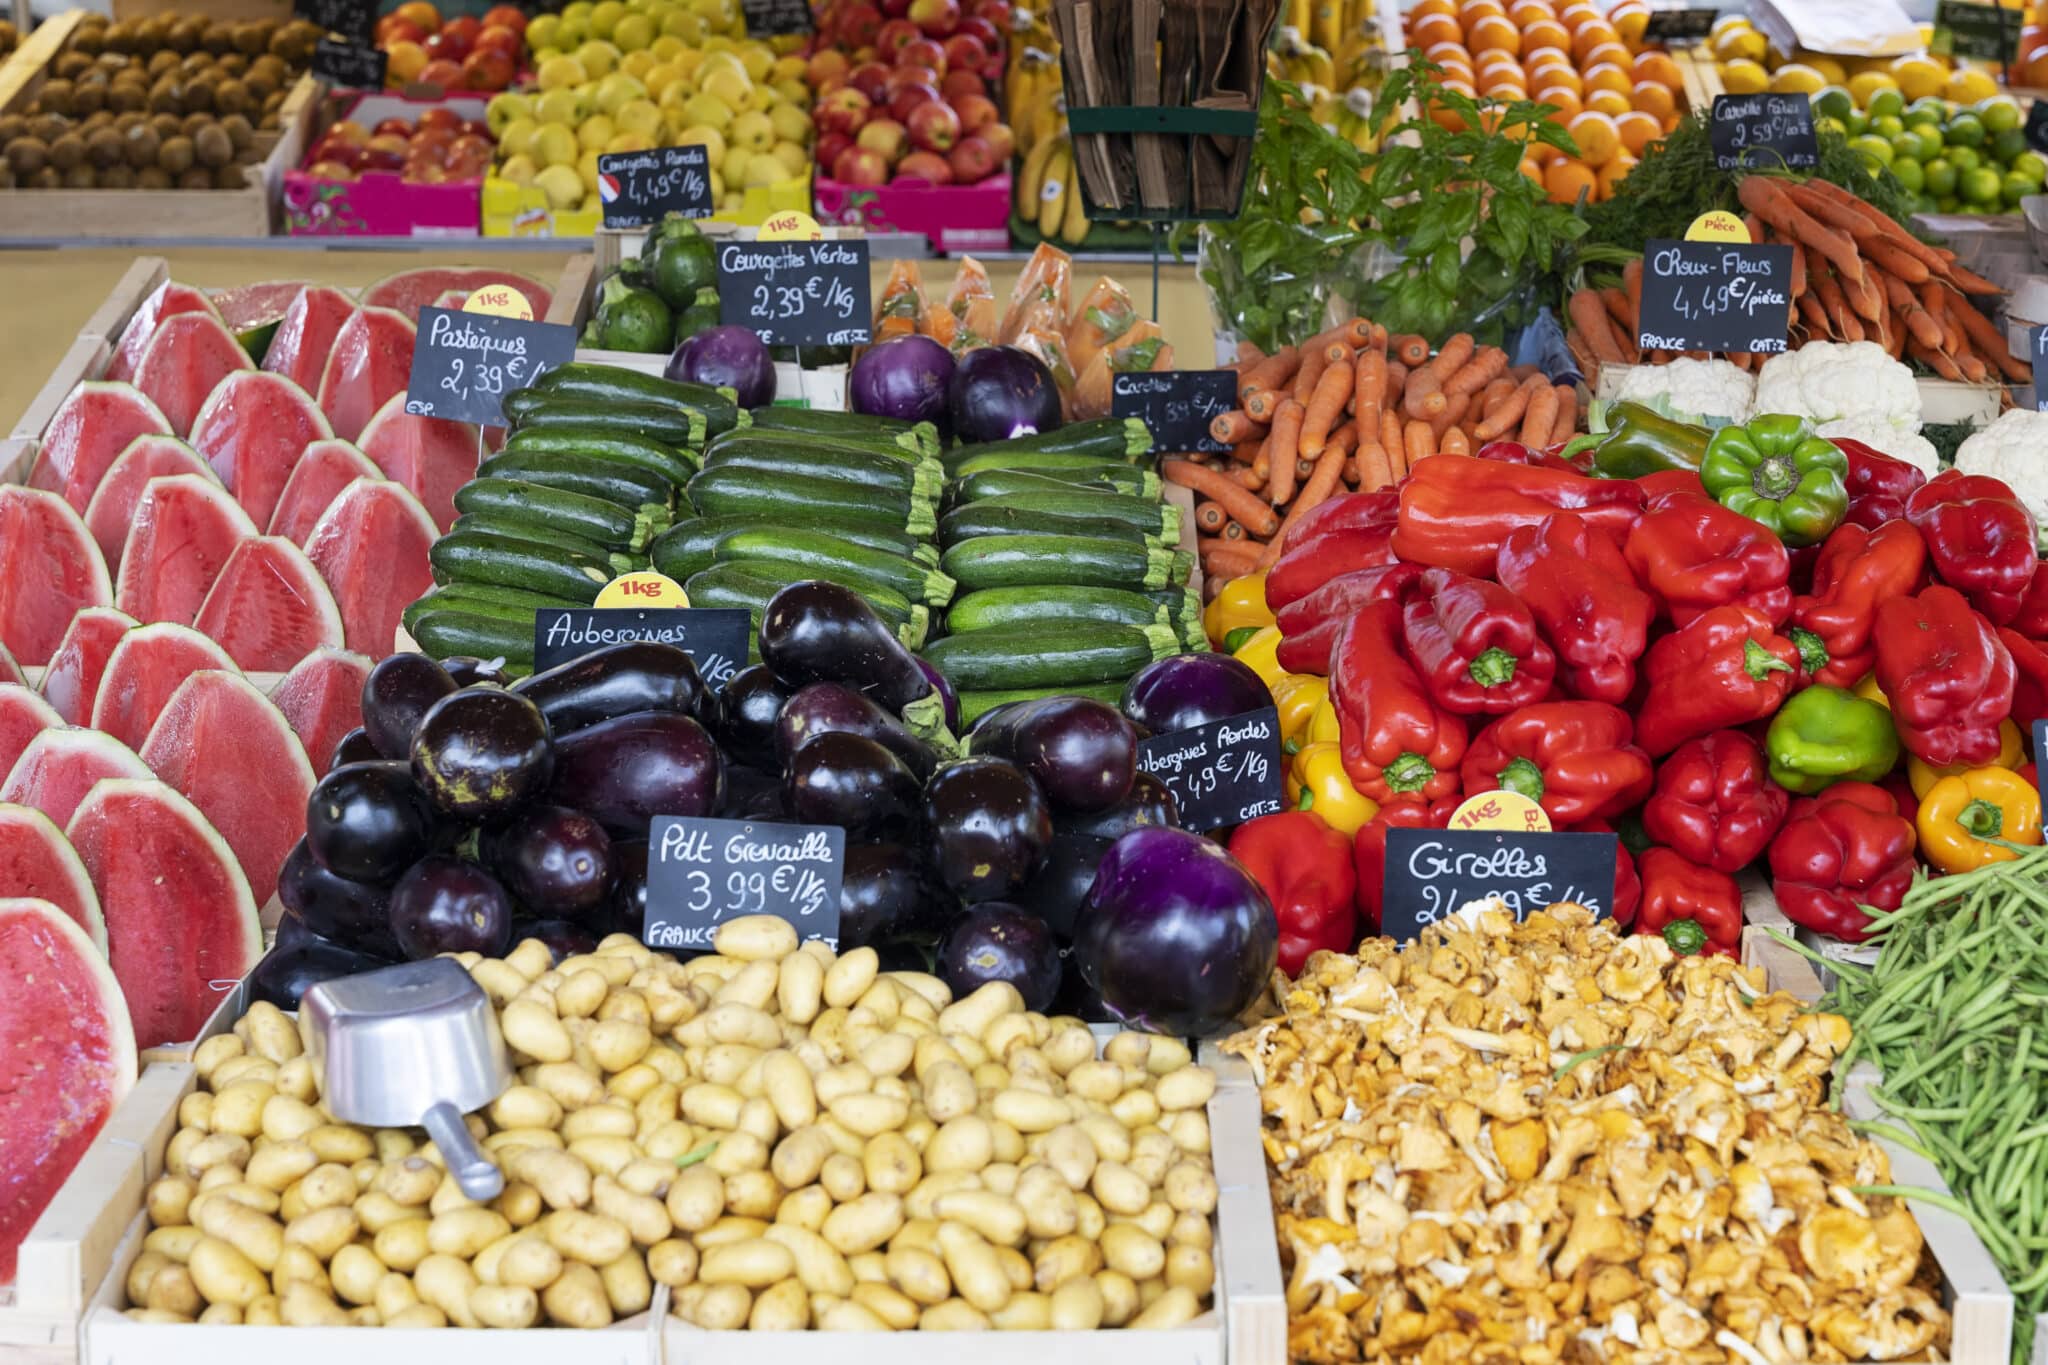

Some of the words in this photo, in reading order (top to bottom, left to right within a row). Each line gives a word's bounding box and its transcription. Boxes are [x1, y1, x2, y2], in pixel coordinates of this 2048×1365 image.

[768, 216, 799, 233] 1kg
[721, 245, 806, 281] Courgettes
[809, 243, 859, 265] Vertes
[478, 291, 510, 307] 1kg
[429, 313, 528, 363] Pastèques
[1640, 333, 1686, 350] FRANCE
[619, 580, 662, 597] 1kg
[1217, 720, 1270, 749] Rondes
[1457, 799, 1503, 829] 1kg
[661, 823, 712, 864] Pdt
[724, 831, 833, 864] Grenaille
[1408, 842, 1548, 880] Girolles
